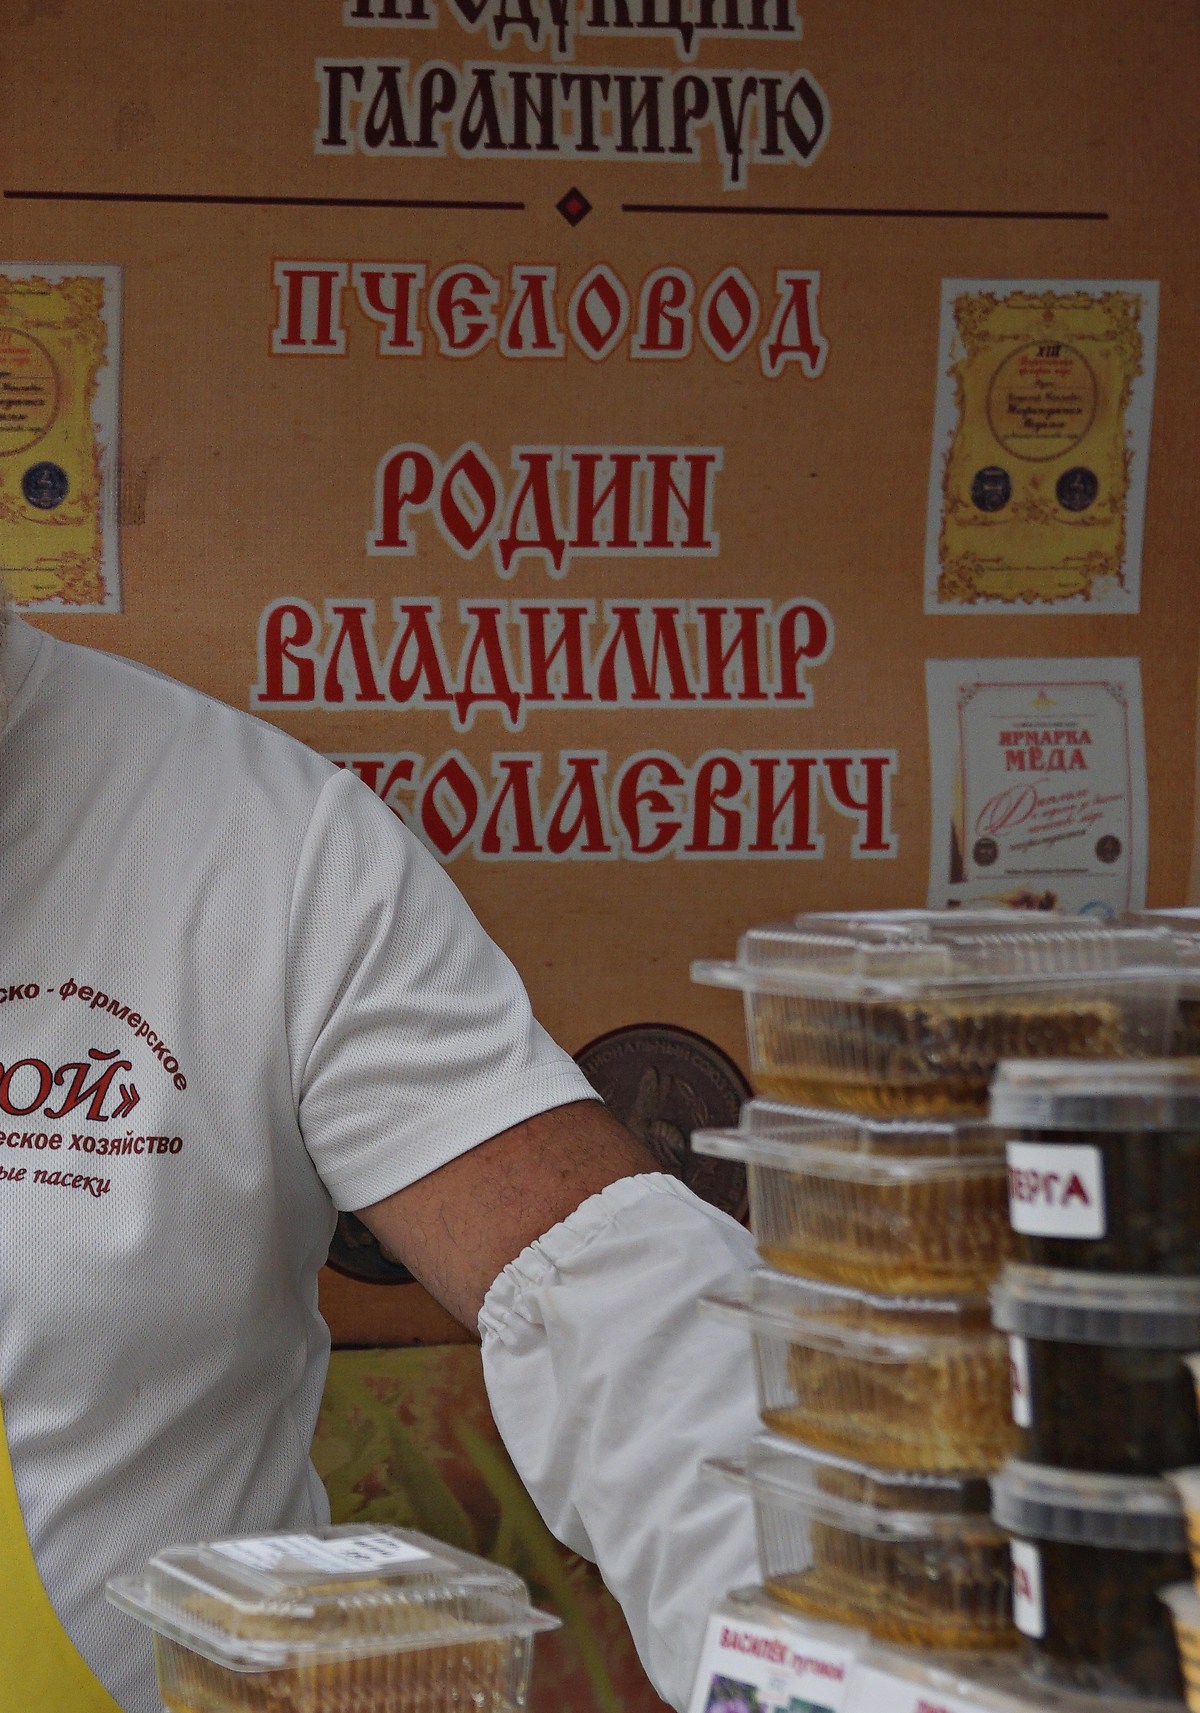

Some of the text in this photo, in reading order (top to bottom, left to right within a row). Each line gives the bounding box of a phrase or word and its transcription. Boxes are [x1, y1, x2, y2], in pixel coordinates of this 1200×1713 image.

[321, 65, 825, 183] ГАРАНТИРУЮ
[280, 268, 822, 370] ПЧЕЛОВОД
[374, 448, 716, 571] РОДИН
[258, 603, 828, 725] ВЛАДИМИР
[332, 757, 891, 856] КОЛАЕВИЧ
[1005, 746, 1088, 772] МЁДА
[58, 977, 188, 1091] фермерское
[33, 1169, 112, 1197] пасеки
[68, 1130, 184, 1156] хозяйство
